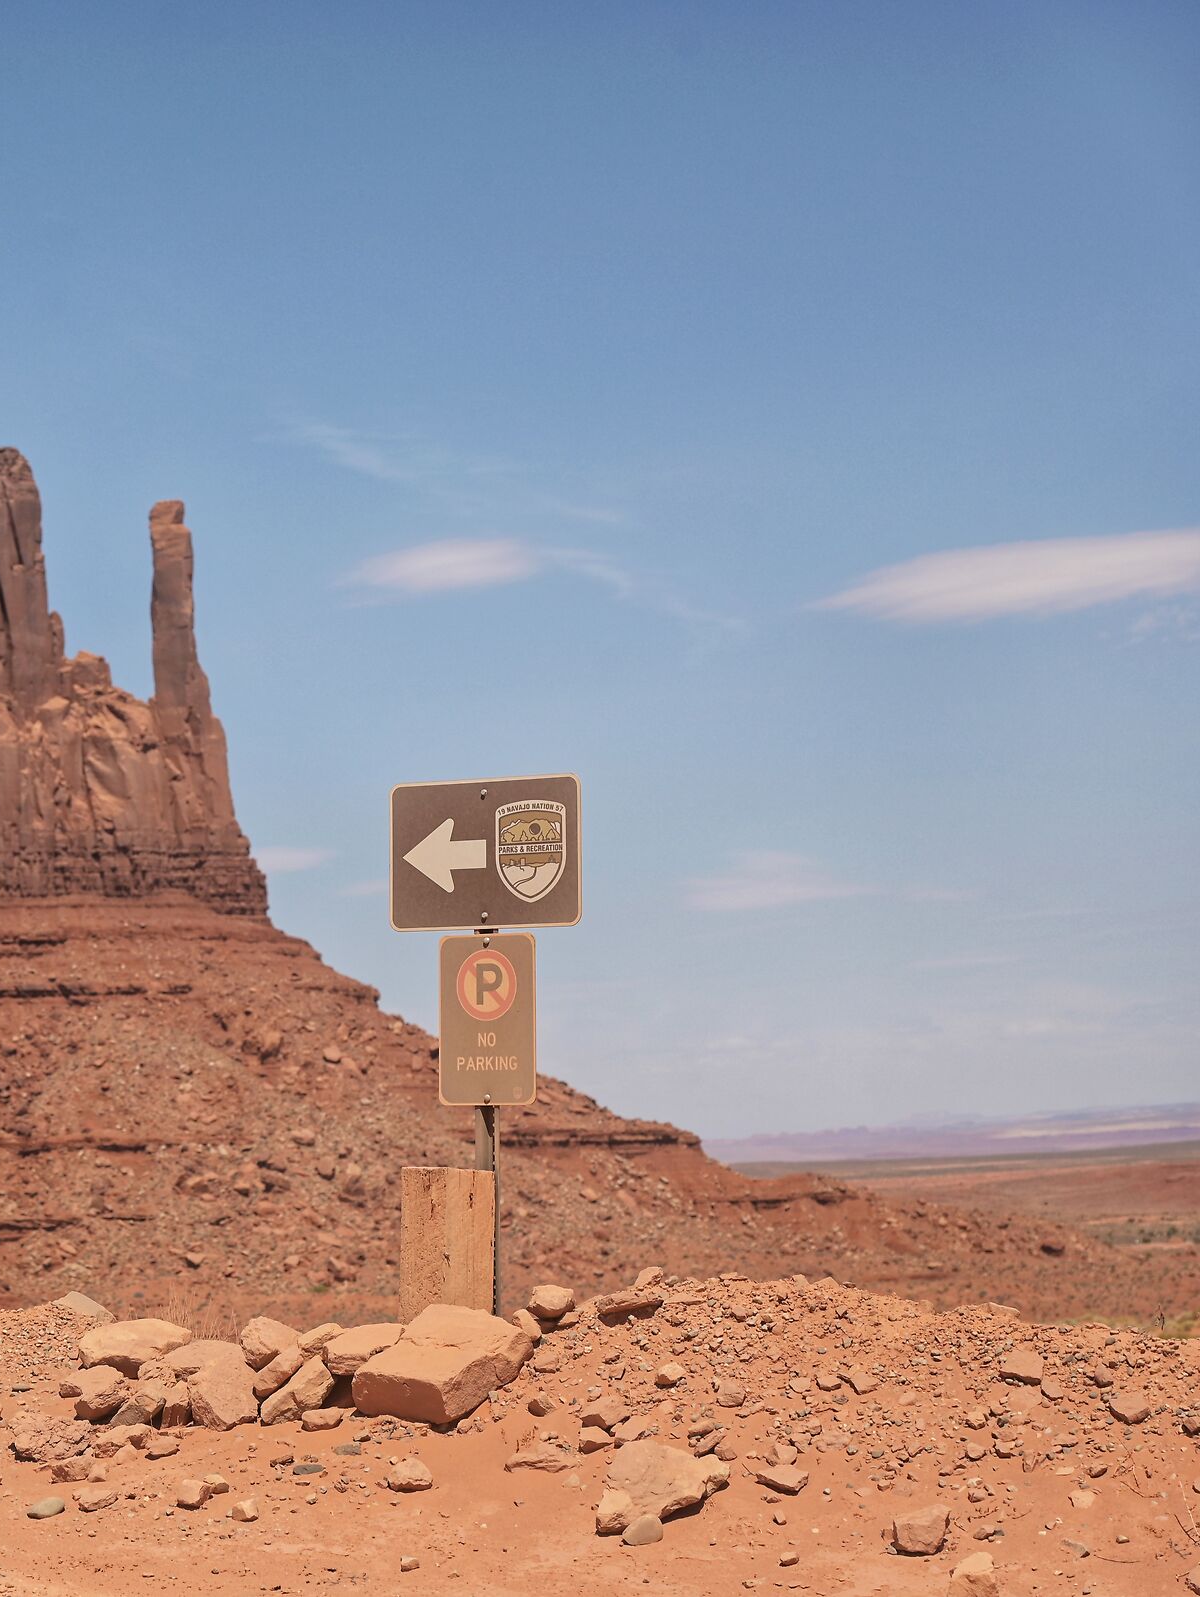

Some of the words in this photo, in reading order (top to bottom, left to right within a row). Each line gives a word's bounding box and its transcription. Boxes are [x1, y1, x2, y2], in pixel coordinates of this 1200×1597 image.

[506, 803, 530, 812] NAVAJO
[498, 845, 518, 854] PARKS
[526, 844, 563, 852] RECREATION
[476, 963, 502, 1005] P
[477, 1032, 497, 1048] NO
[456, 1055, 518, 1071] PARKING
